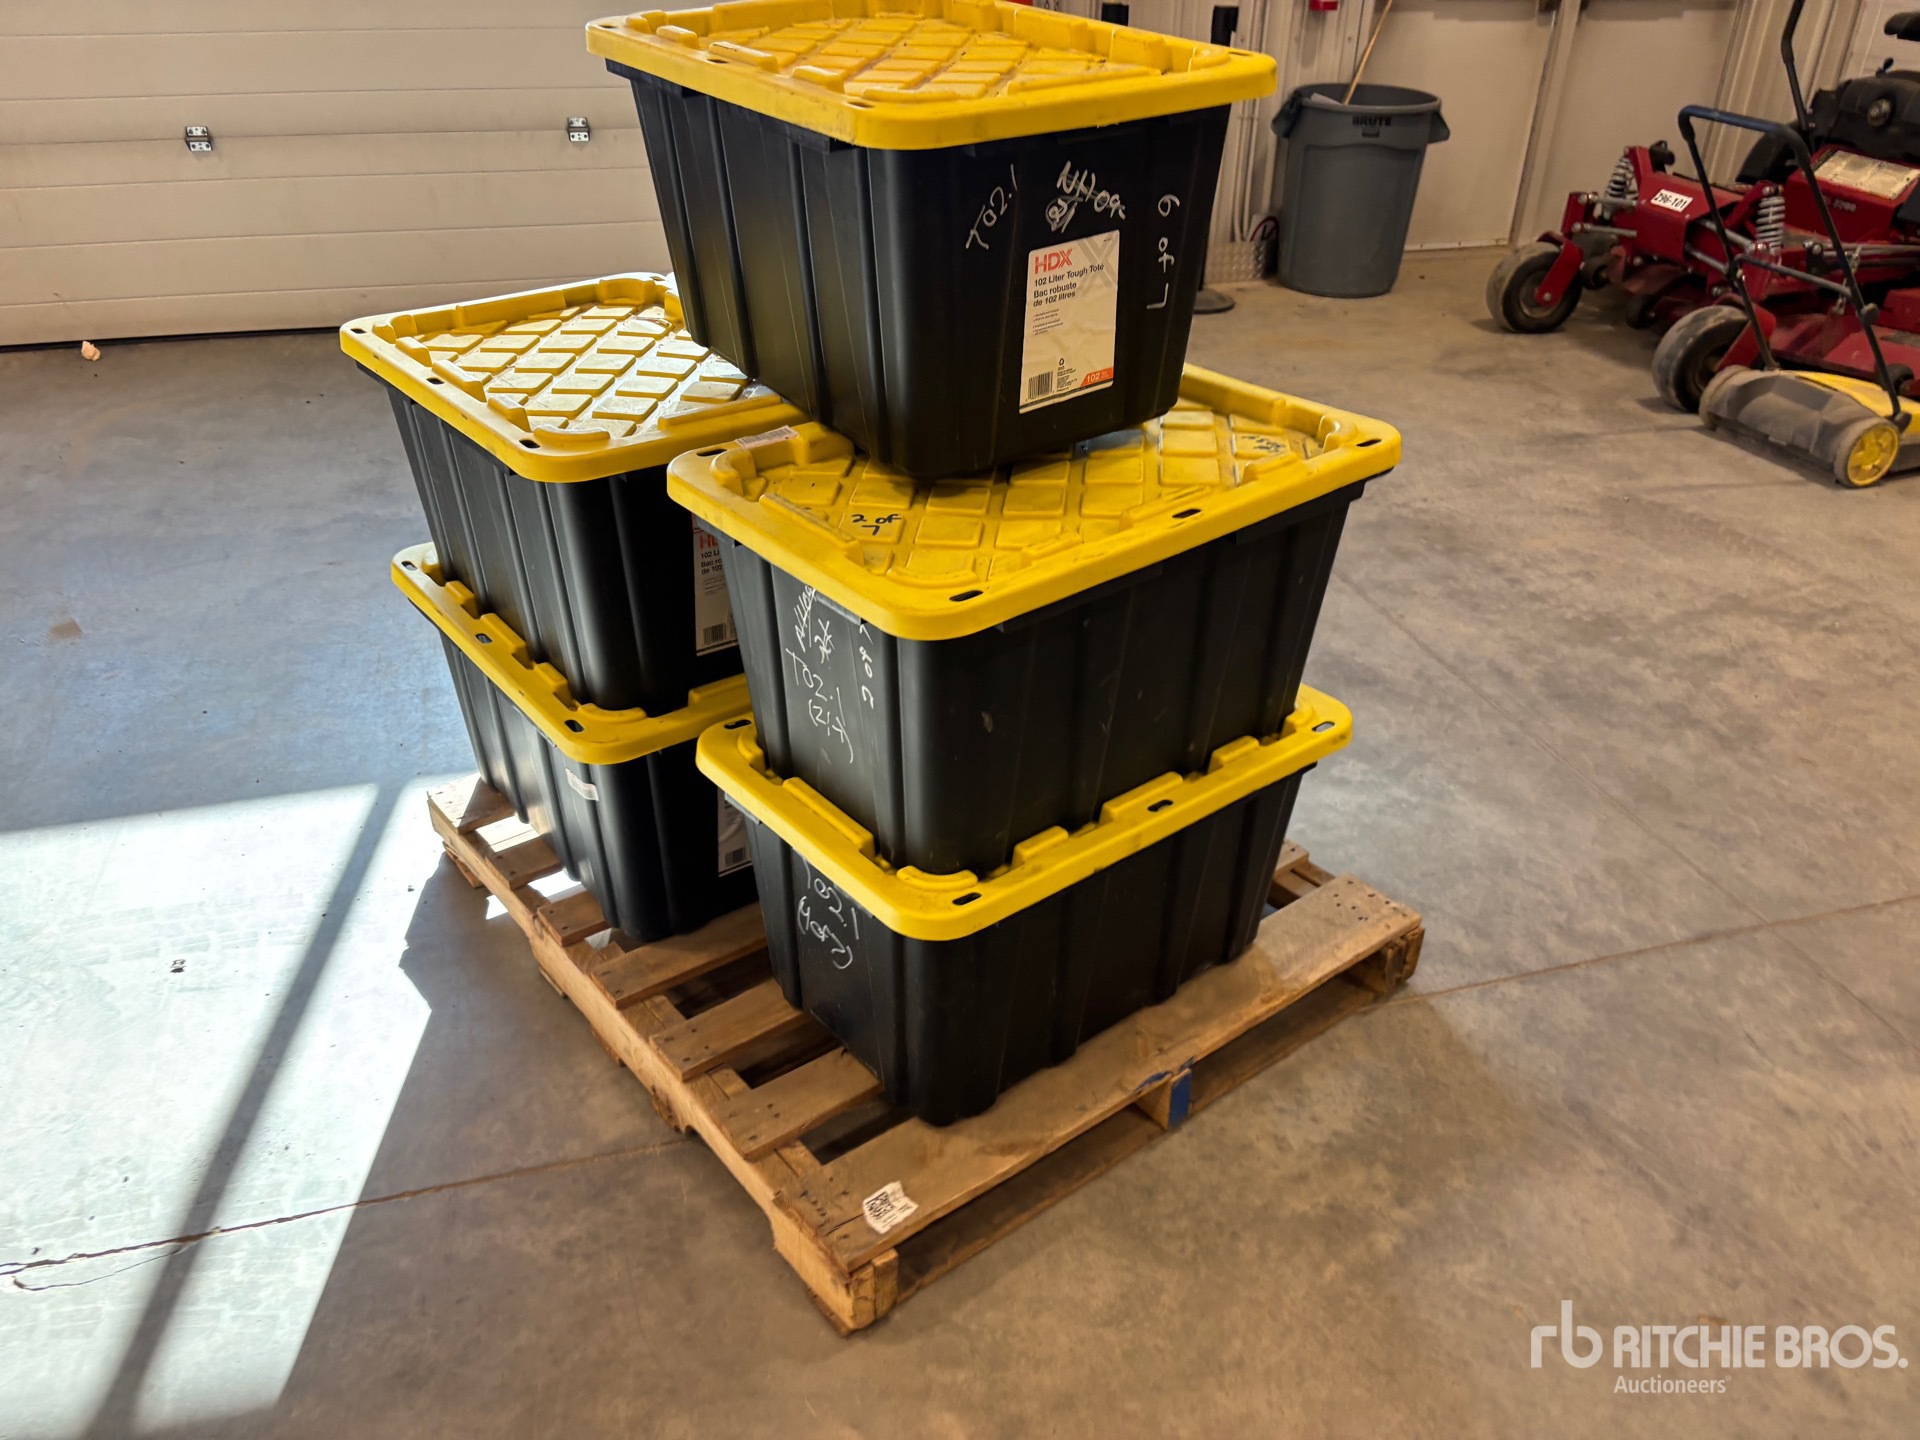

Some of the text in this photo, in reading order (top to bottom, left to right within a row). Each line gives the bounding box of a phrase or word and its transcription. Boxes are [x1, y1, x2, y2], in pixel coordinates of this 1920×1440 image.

[1352, 115, 1392, 126] BRUTE
[1034, 248, 1073, 275] HDX
[1034, 263, 1105, 287] 102 Liter Tough Tote
[1033, 281, 1077, 299] Bac robuste
[1033, 290, 1076, 308] de 102 litres
[1086, 372, 1101, 383] 102
[852, 513, 902, 524] 2 of
[700, 551, 713, 559] 102
[700, 560, 714, 568] Bac
